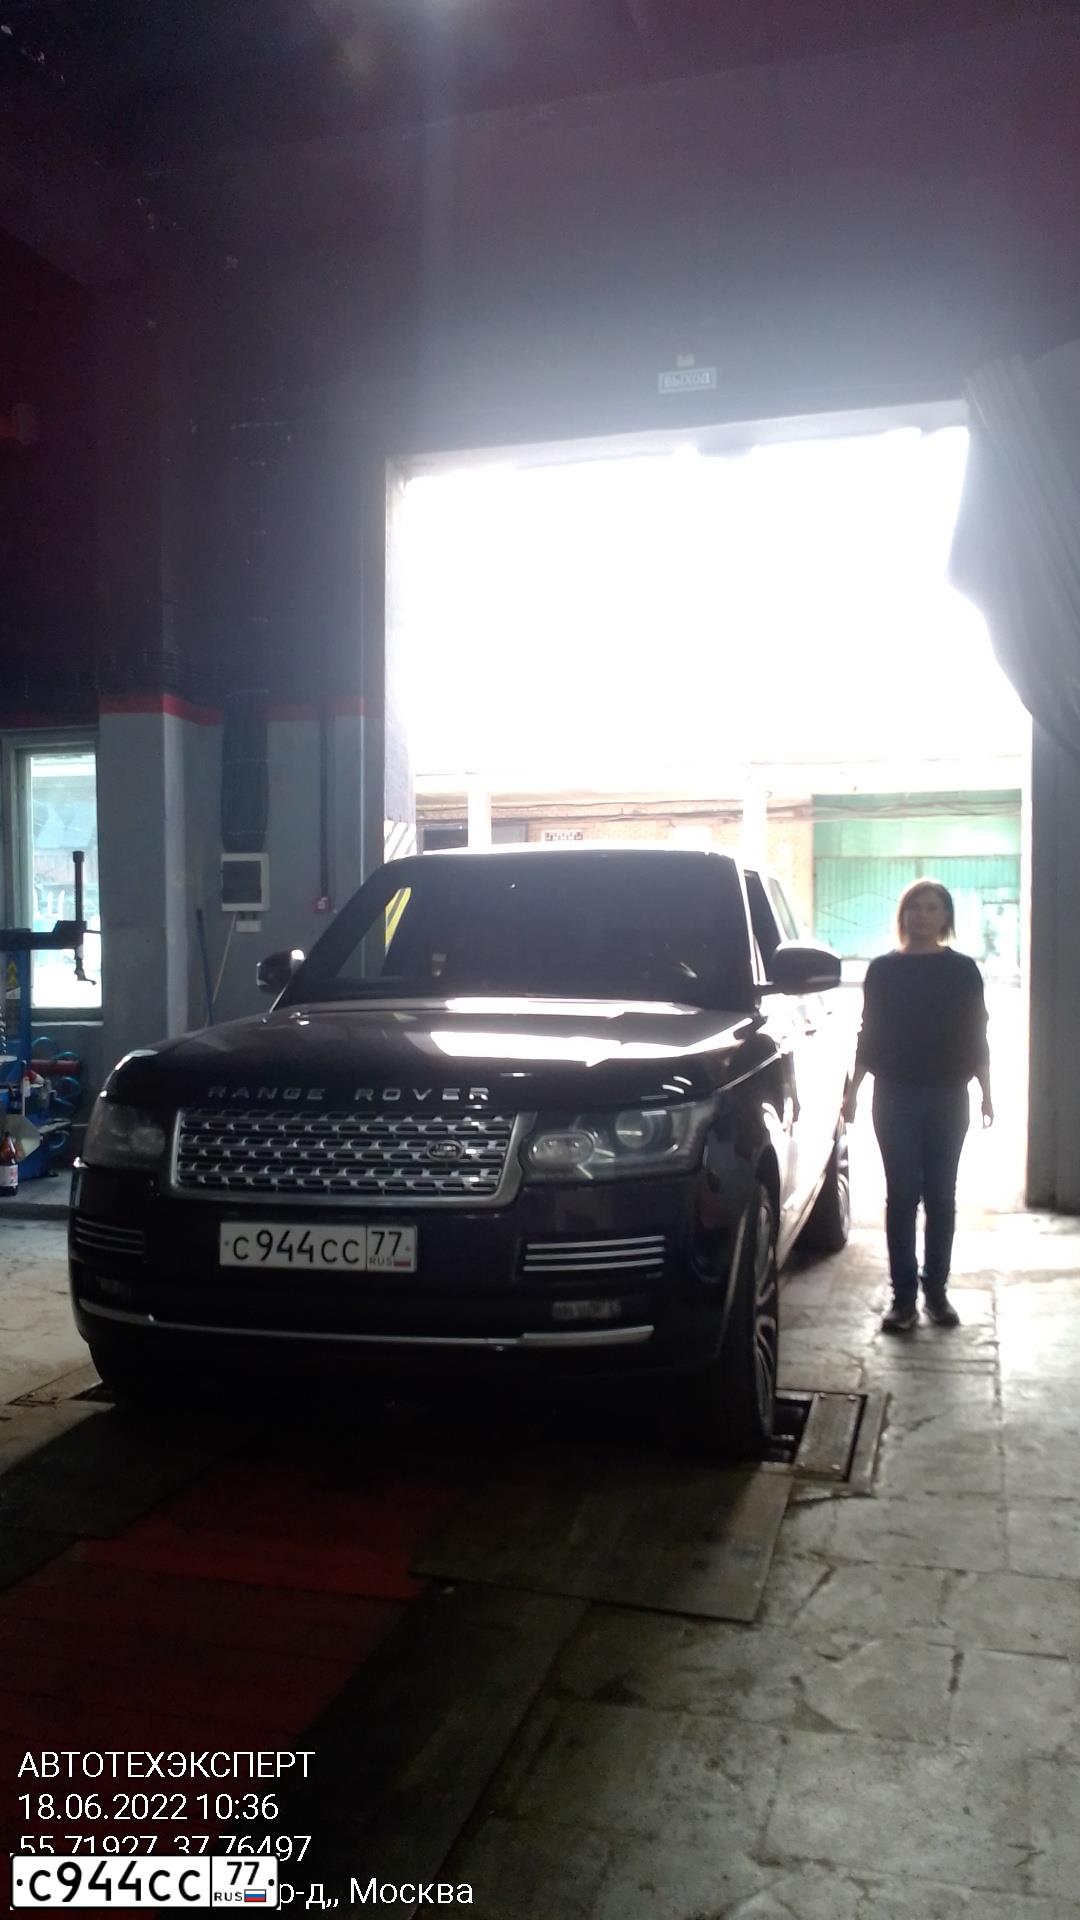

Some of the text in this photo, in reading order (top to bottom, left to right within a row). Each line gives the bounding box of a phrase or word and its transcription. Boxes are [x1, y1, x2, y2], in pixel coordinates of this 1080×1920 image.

[207, 1085, 489, 1102] RANGE ROVER
[371, 1230, 402, 1257] 77
